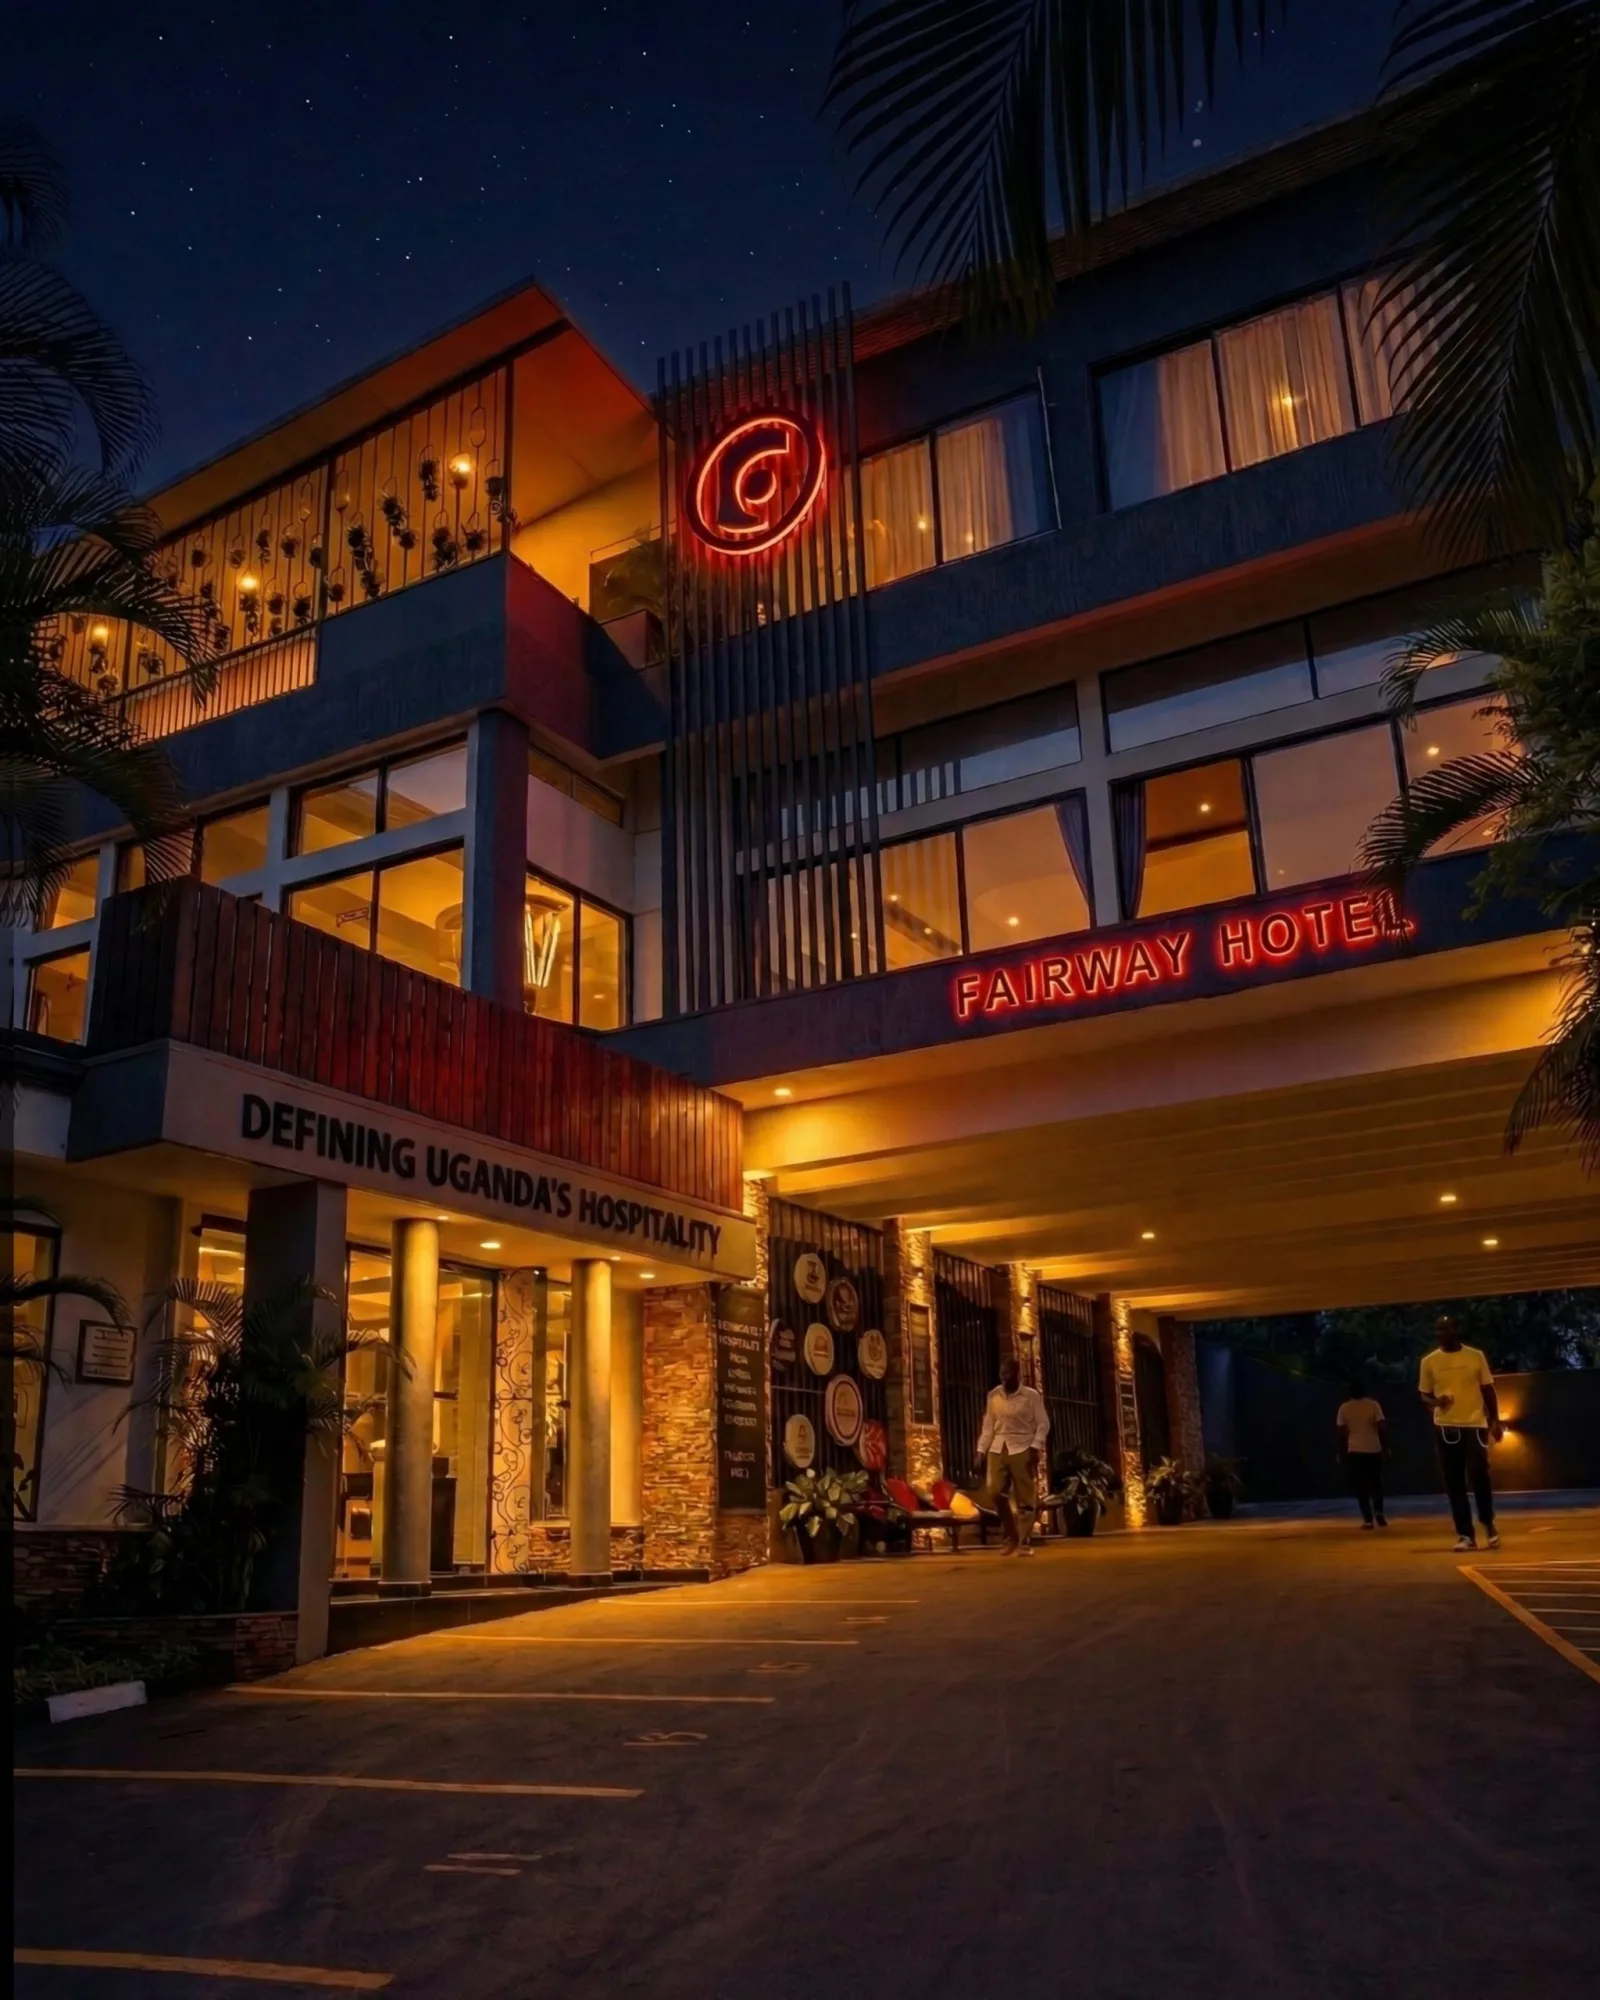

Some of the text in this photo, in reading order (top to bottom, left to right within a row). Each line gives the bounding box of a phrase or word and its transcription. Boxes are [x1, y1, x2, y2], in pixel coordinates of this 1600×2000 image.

[955, 889, 1414, 1018] FAIRWAY HOTEL
[240, 1093, 722, 1257] DEFINING UGANDA'S HOSPITALITY
